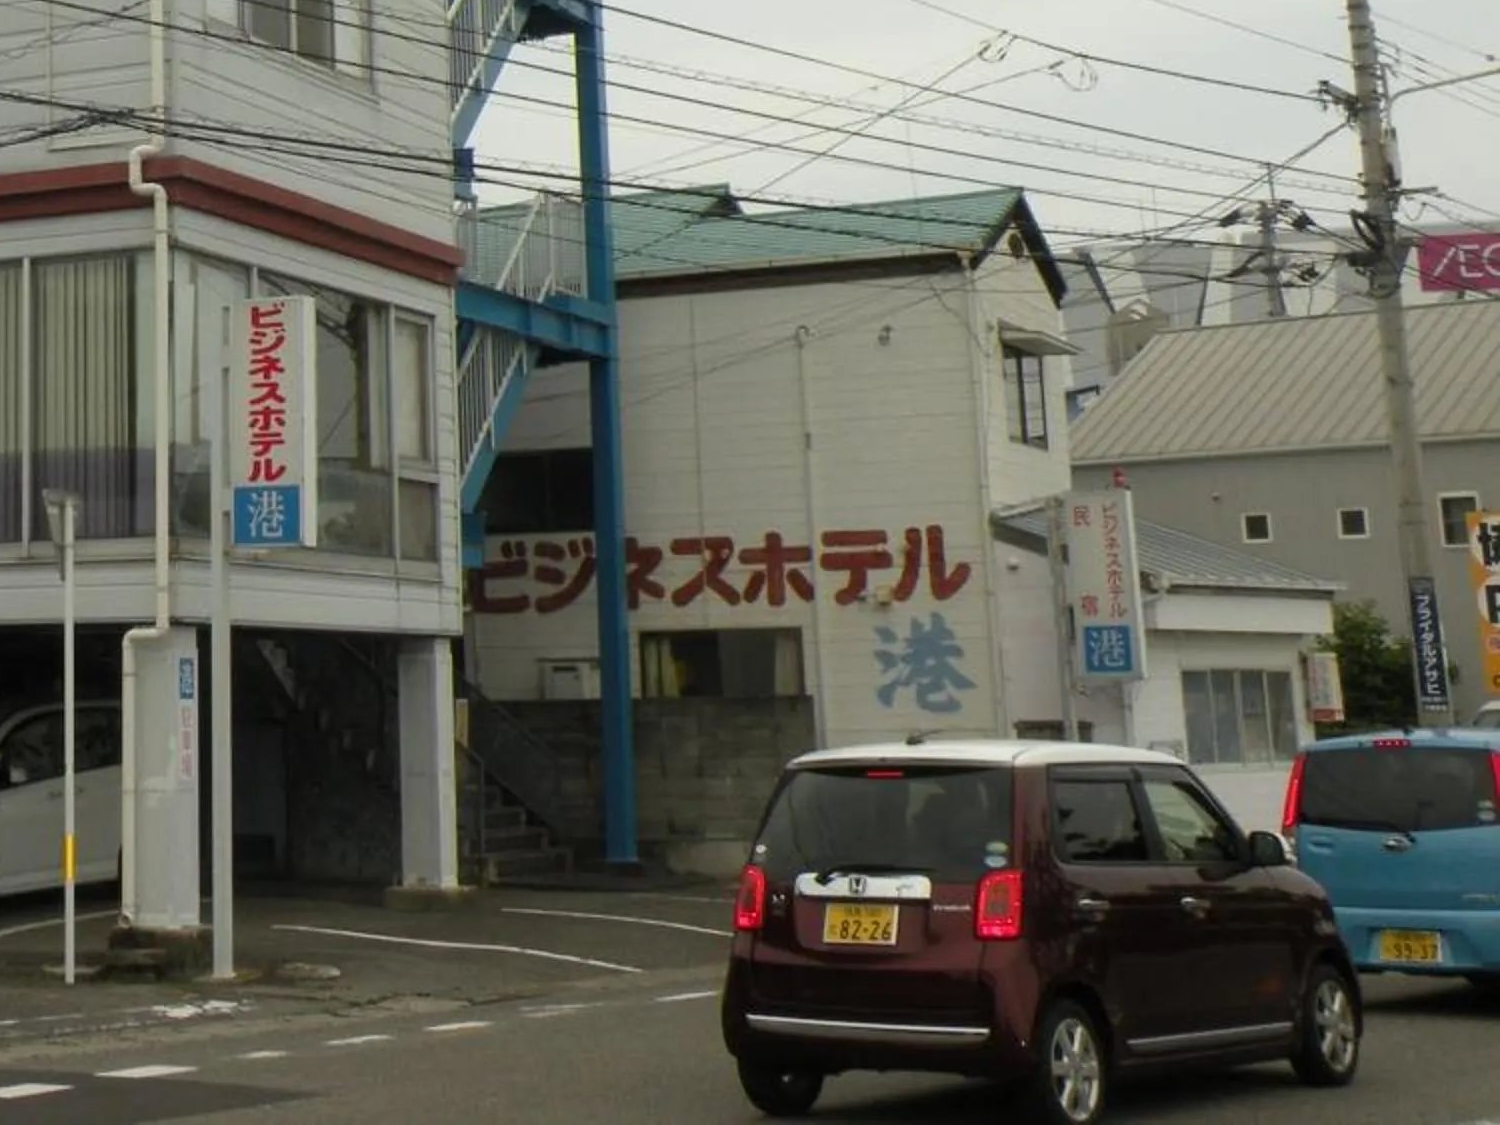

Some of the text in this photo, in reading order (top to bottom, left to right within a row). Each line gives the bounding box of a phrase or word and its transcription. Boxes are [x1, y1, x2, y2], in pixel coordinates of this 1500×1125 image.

[248, 301, 287, 483] ビジネスホテル
[247, 490, 286, 539] 港
[468, 524, 971, 614] ビジネスホテル
[872, 611, 976, 714] 港
[1088, 628, 1126, 667] 港
